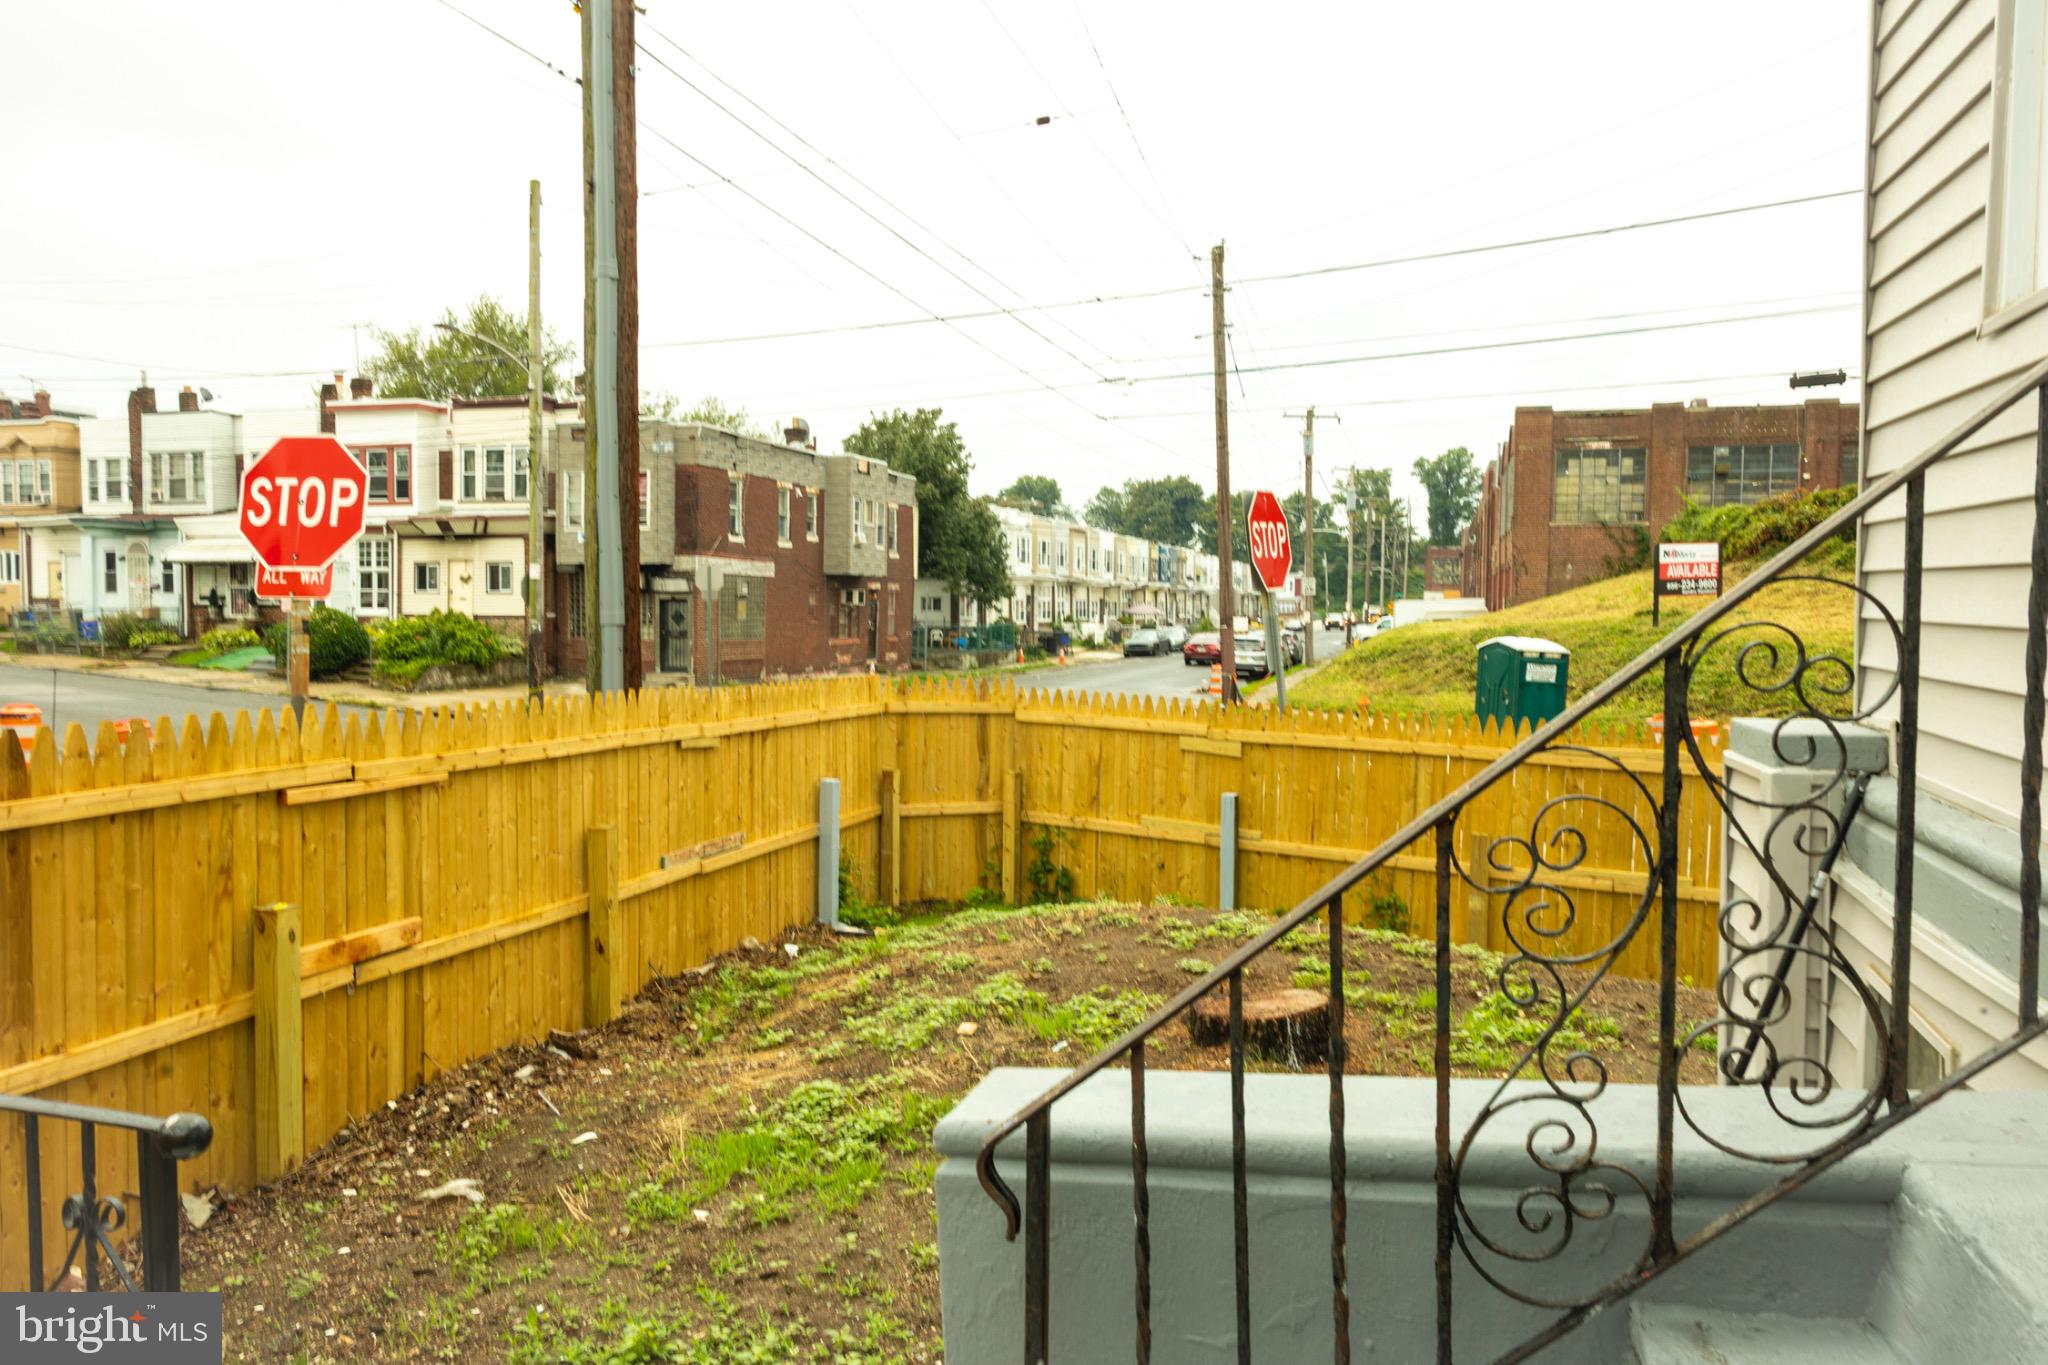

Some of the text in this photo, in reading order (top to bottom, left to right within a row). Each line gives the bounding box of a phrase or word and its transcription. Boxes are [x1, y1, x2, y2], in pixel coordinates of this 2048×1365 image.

[247, 476, 359, 528] STOP
[1252, 521, 1286, 559] STOP
[262, 571, 328, 585] ALL WAY
[1667, 562, 1718, 578] AVAILABLE
